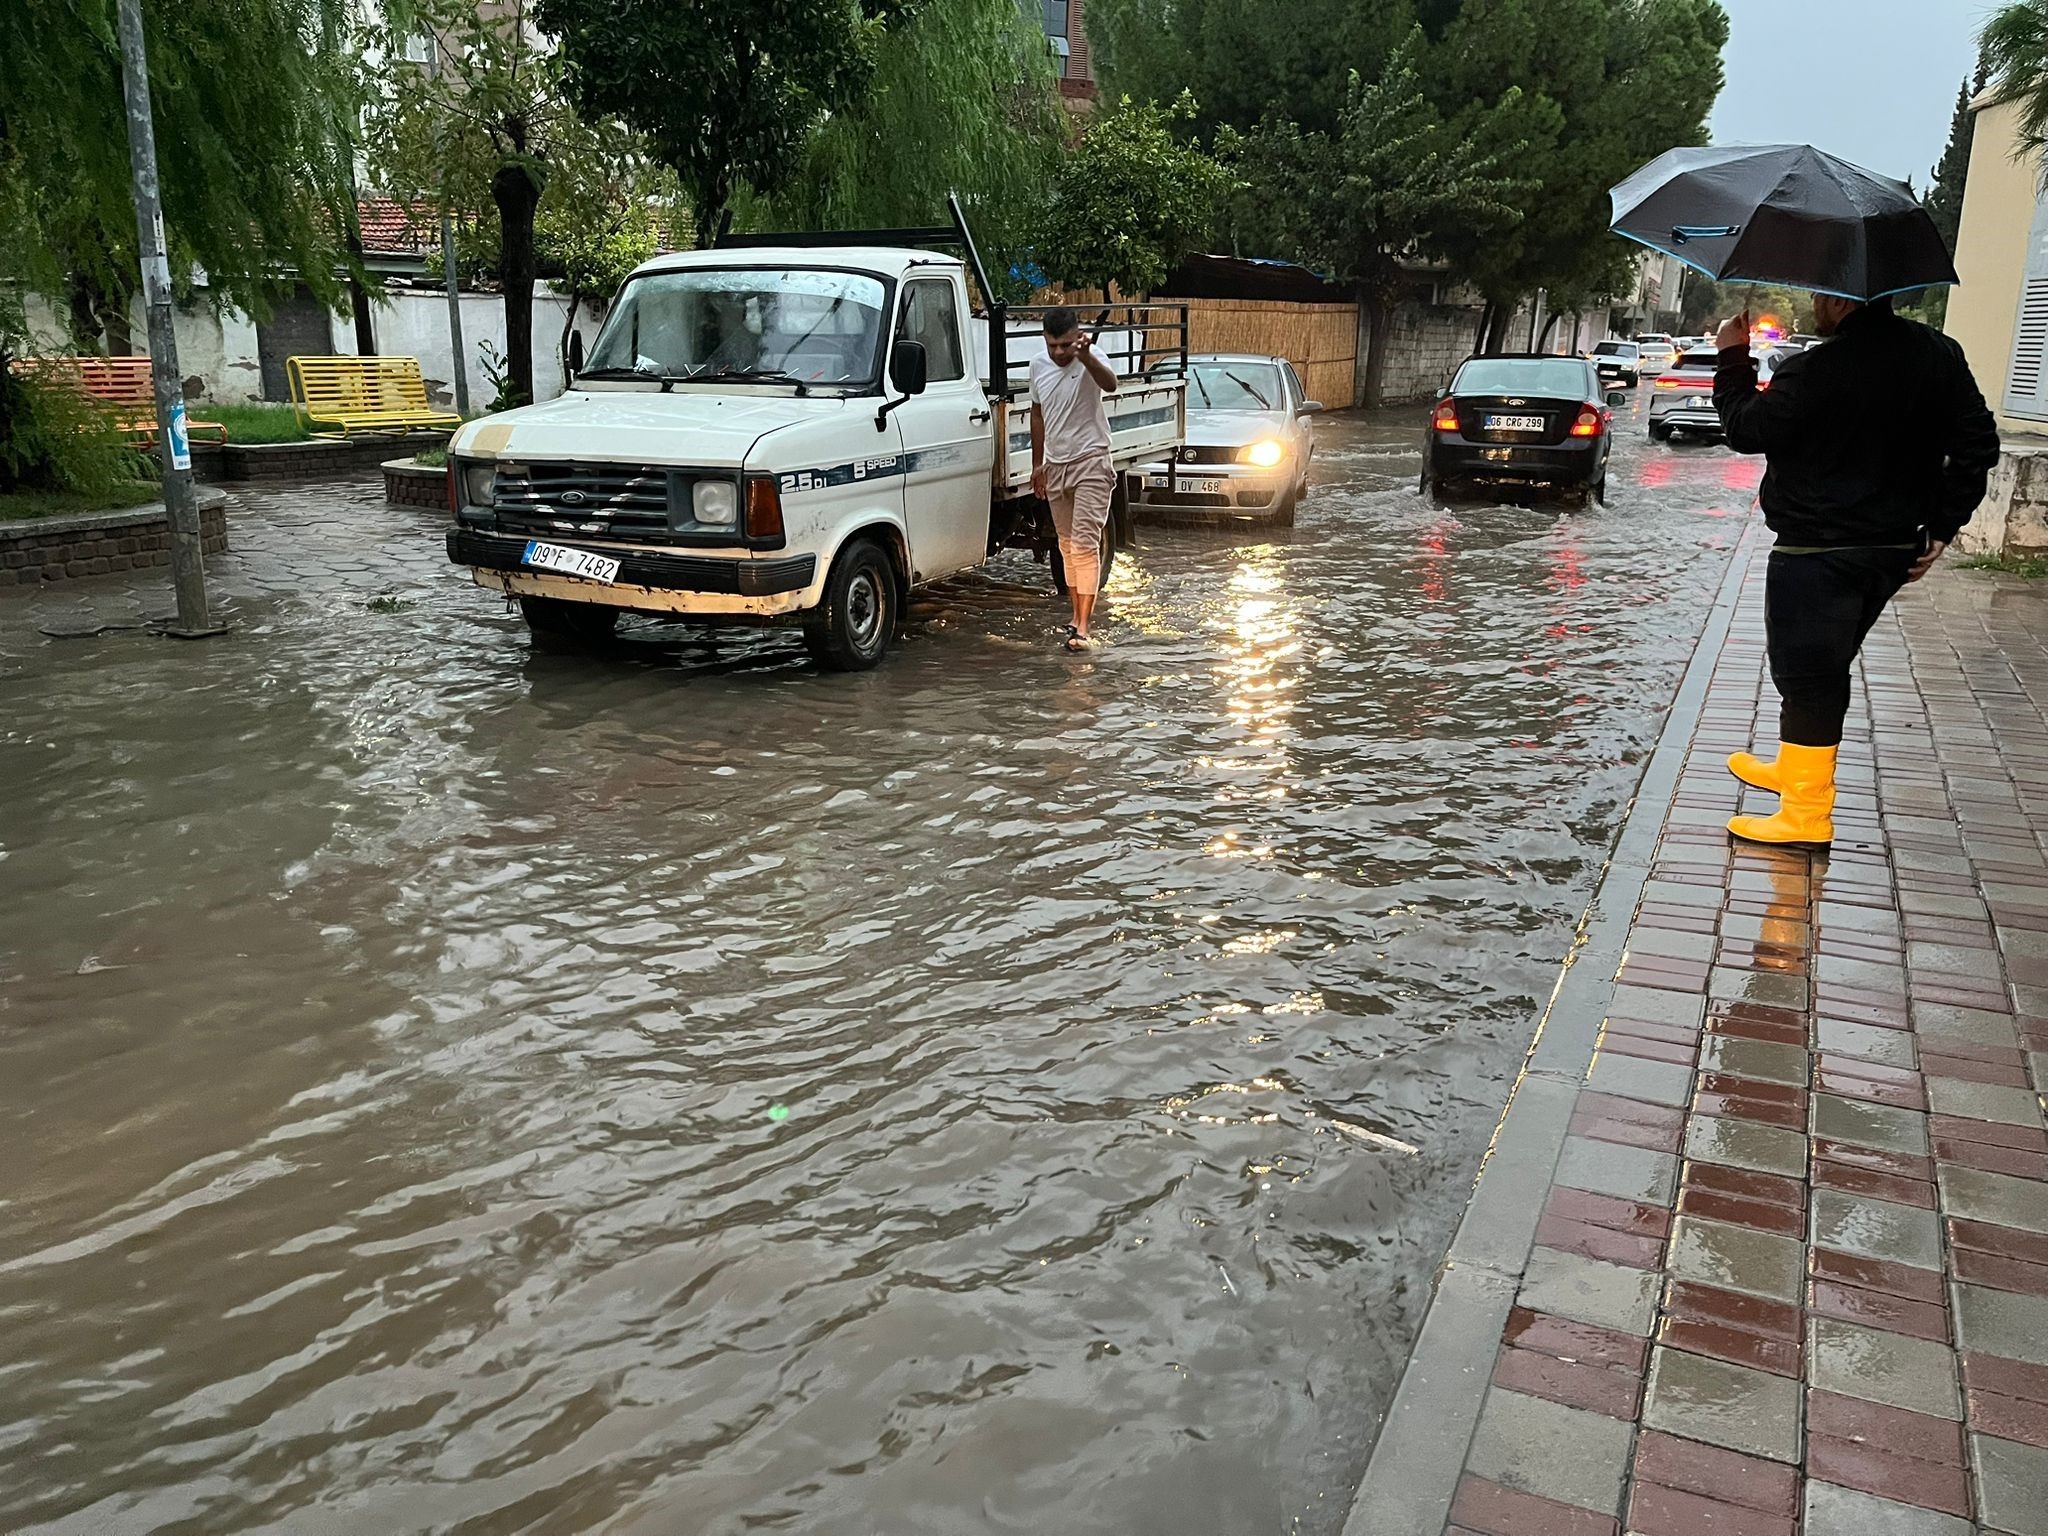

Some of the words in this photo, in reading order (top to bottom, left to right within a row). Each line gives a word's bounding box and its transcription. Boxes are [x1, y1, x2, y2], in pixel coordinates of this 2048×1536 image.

[1491, 417, 1501, 427] 06
[1506, 417, 1522, 427] CRG
[1526, 418, 1542, 428] 299
[867, 456, 897, 470] SPEED
[1201, 481, 1219, 492] 468
[532, 545, 550, 563] 09
[553, 549, 566, 566] F
[576, 553, 615, 579] 7482
